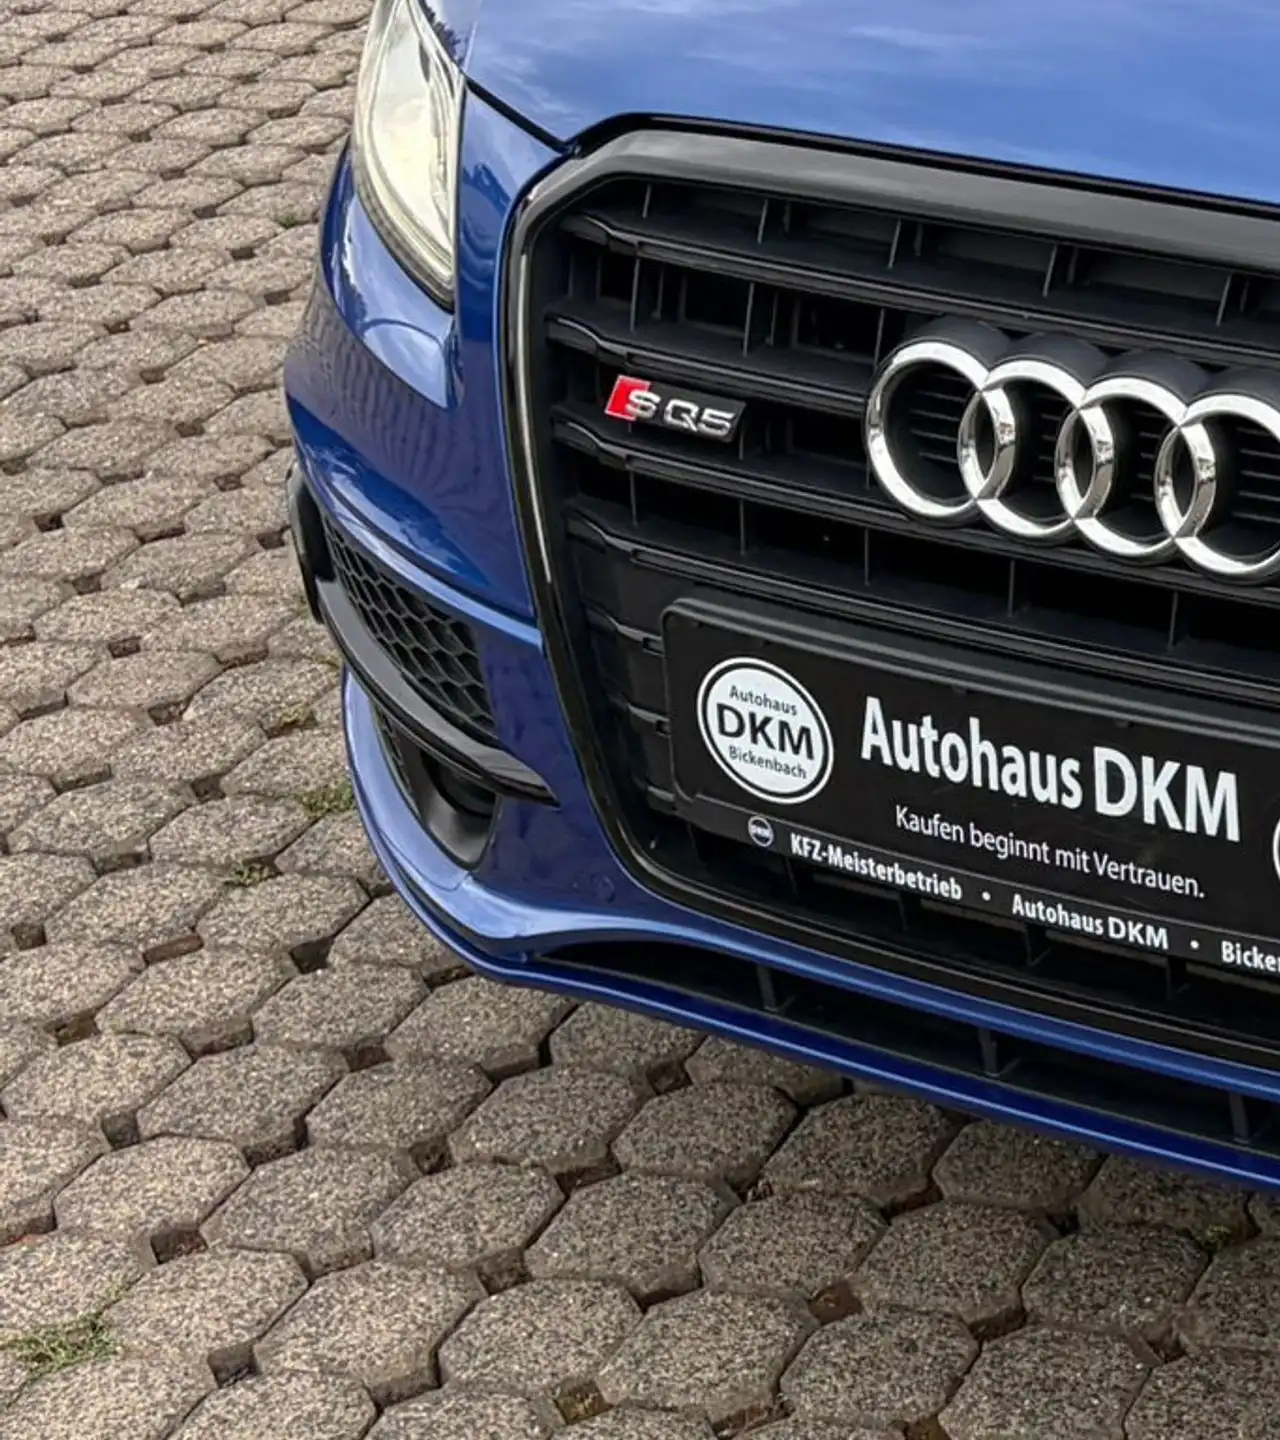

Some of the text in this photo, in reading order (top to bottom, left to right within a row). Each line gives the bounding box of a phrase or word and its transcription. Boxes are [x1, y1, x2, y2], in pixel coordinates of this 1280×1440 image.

[729, 685, 798, 716] Autohaus
[716, 702, 814, 761] DKM
[728, 745, 807, 779] Bickenbach
[860, 695, 1240, 842] Autohaus DKM
[790, 833, 963, 900] KFZ-Meisterbetrieb
[895, 805, 1205, 899] Kaufen beginnt mit Vertrauen.
[1012, 893, 1169, 950] Autohaus DKM
